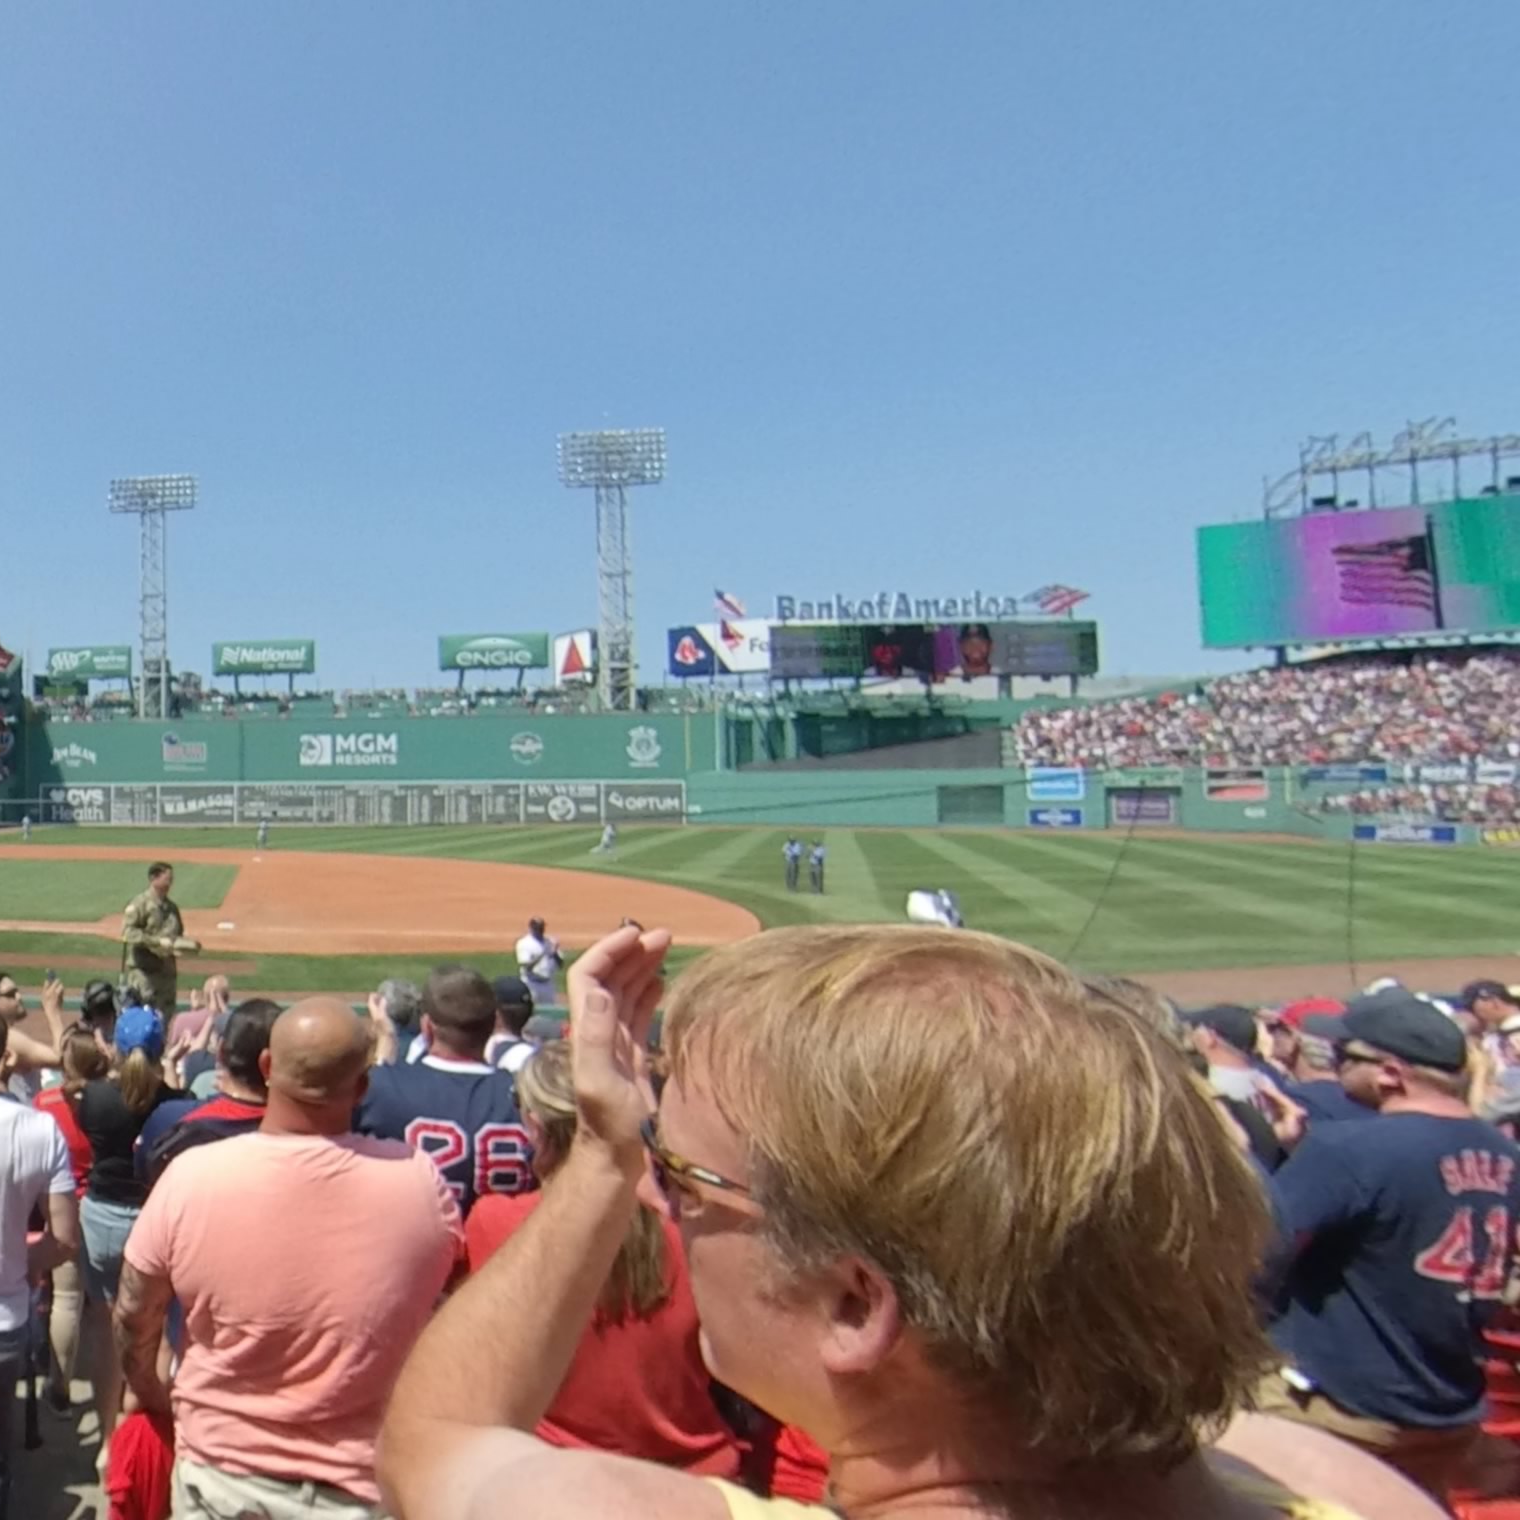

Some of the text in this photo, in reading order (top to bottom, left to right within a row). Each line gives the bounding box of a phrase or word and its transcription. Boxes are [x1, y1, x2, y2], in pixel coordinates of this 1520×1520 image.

[777, 590, 1018, 620] Bank of America
[240, 647, 306, 664] National
[335, 733, 398, 753] MGM
[335, 754, 398, 766] RESORTS
[66, 788, 104, 806] CVS
[624, 795, 680, 812] OPTUM
[51, 804, 104, 821] Health
[404, 1116, 534, 1200] 26
[1439, 1149, 1515, 1196] SALE
[1413, 1206, 1509, 1300] 41
